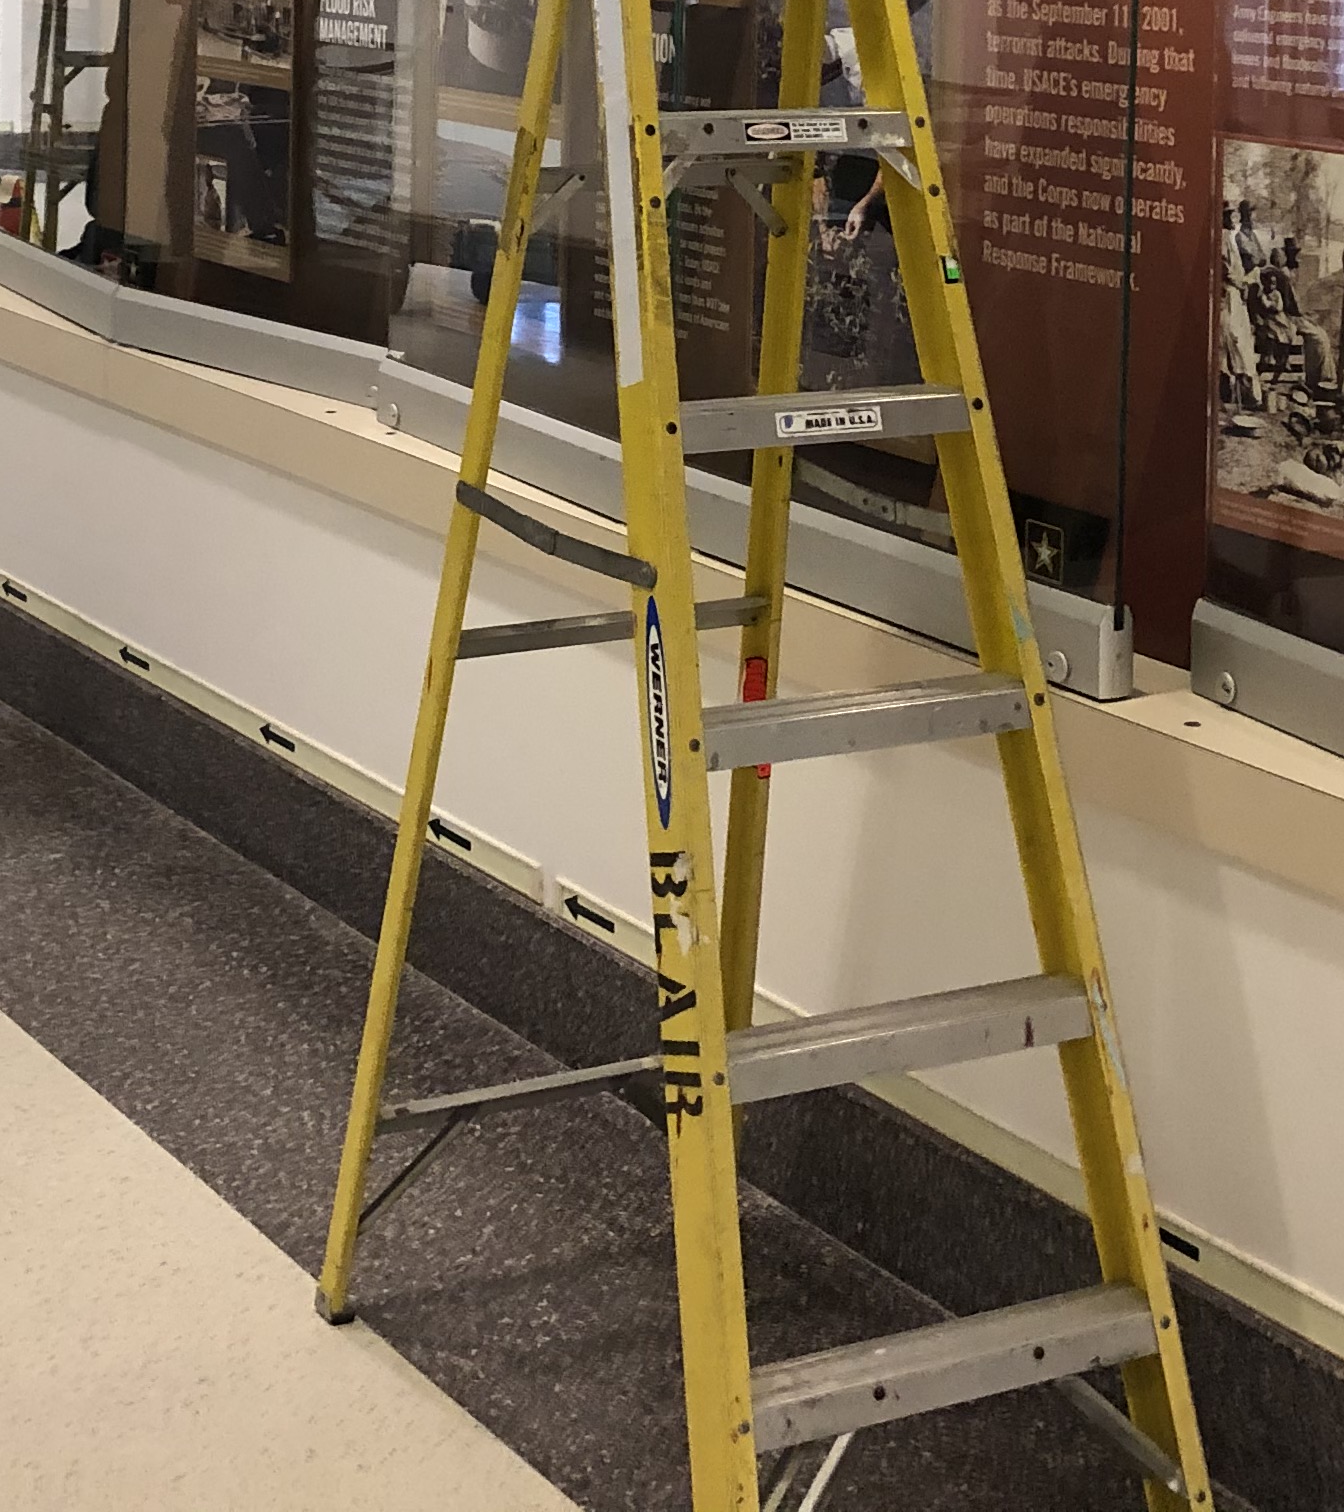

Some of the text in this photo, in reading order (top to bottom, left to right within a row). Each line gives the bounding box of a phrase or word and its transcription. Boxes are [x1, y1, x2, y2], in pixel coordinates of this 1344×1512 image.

[1142, 5, 1182, 34] 2001,
[318, 20, 389, 50] MANAGEMENT
[1047, 36, 1102, 62] attacks.
[985, 104, 1056, 129] operations
[985, 134, 1086, 169] have expanded
[1038, 179, 1077, 210] Corps
[1003, 213, 1029, 236] part
[982, 240, 1046, 273] Response
[650, 641, 668, 785] WERNER
